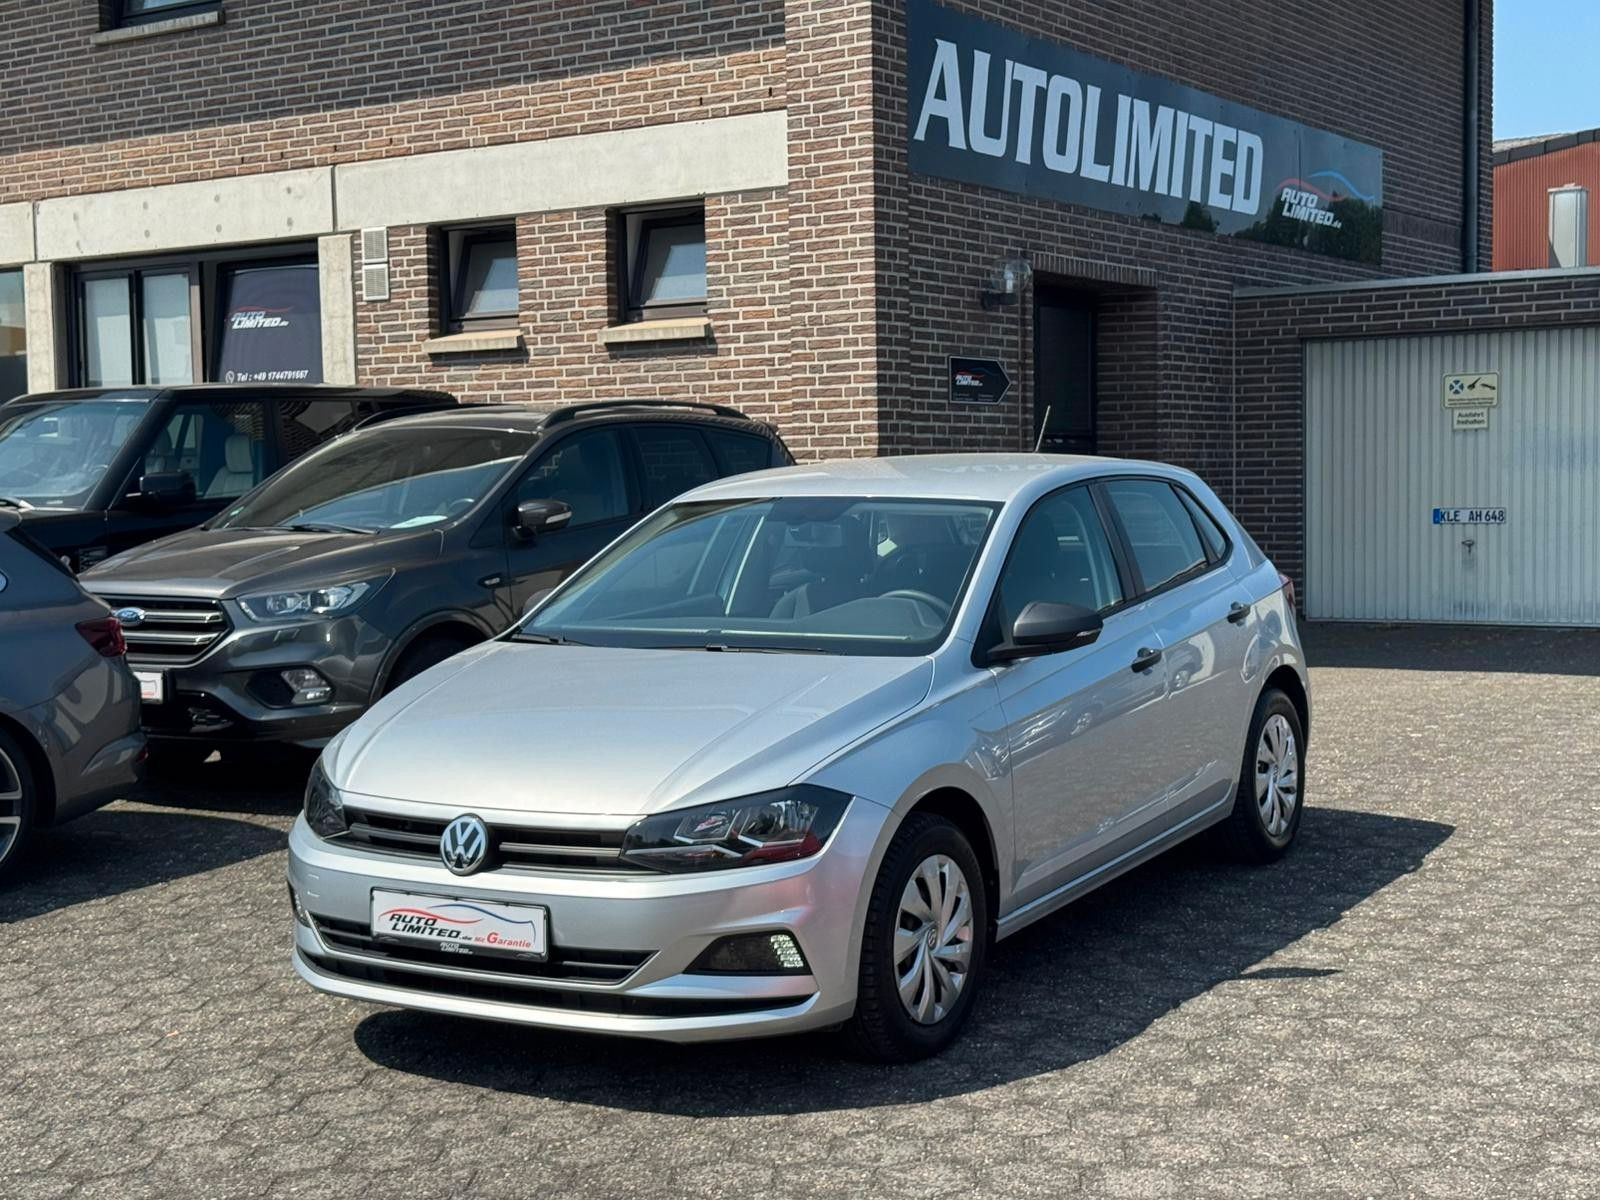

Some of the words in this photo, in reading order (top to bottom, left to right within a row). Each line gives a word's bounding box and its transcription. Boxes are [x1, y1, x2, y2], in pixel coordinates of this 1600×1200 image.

[913, 38, 1263, 215] AUTOLIMITED
[1280, 187, 1318, 208] AUTO
[231, 311, 266, 321] AUTO
[1440, 510, 1460, 522] KLE
[1468, 510, 1482, 522] AH
[1484, 510, 1504, 522] 648
[389, 913, 438, 927] AUTO
[486, 931, 532, 949] Garantie
